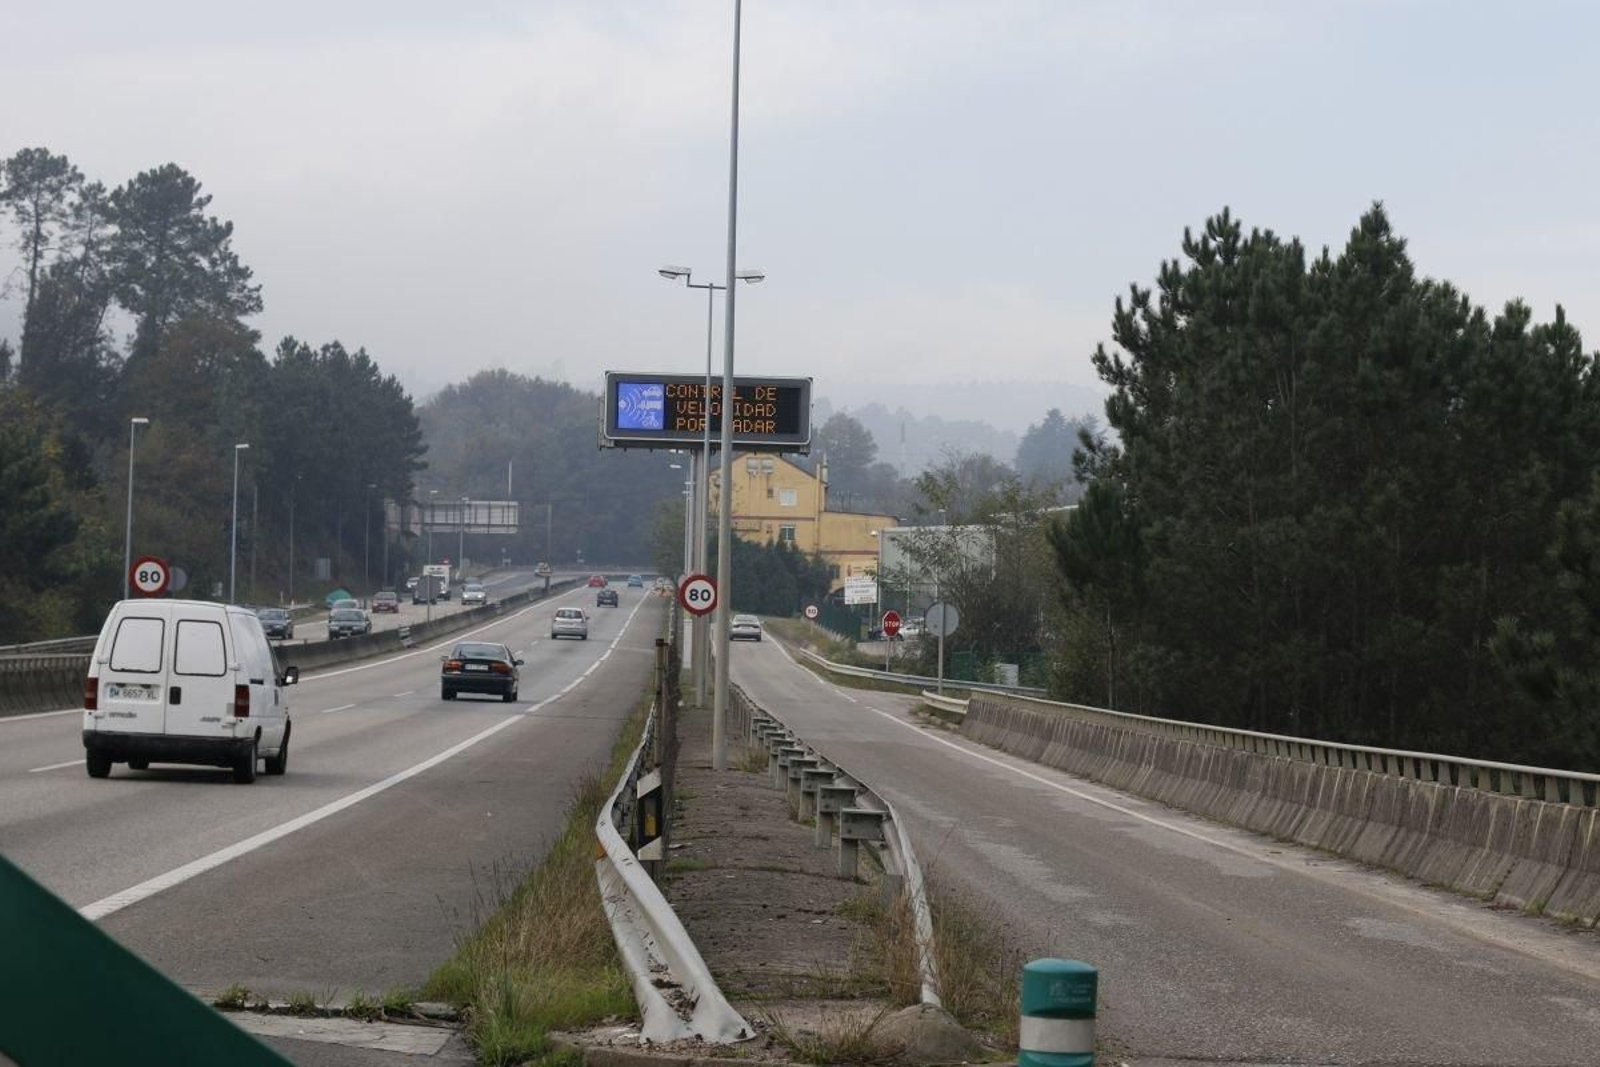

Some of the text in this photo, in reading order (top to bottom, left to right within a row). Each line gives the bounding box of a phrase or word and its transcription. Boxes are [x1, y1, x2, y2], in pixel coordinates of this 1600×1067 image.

[666, 384, 777, 401] CONTRL DE
[677, 400, 776, 417] VELOIDAD
[732, 419, 776, 433] ADAR
[139, 570, 161, 583] 80
[689, 588, 711, 602] 80
[884, 620, 900, 628] STOP
